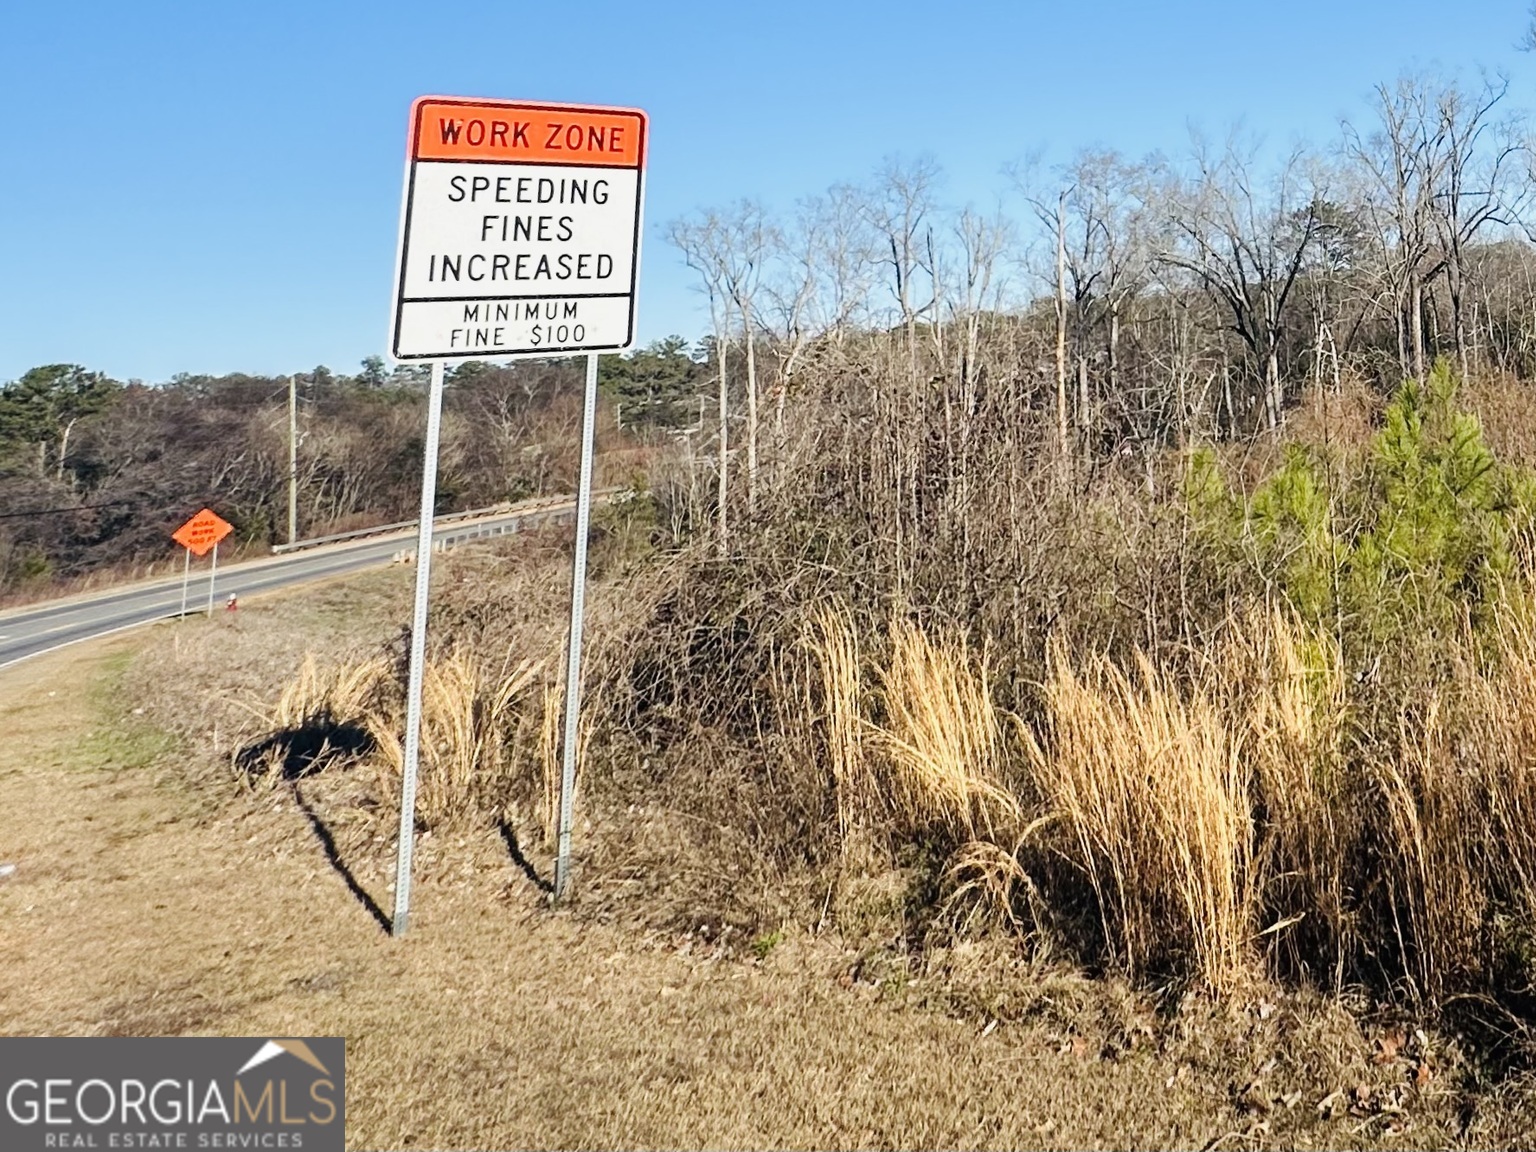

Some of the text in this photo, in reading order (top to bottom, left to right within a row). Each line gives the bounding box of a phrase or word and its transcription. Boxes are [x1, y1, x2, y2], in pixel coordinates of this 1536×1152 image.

[439, 118, 625, 153] WORK ZONE
[448, 176, 610, 205] SPEEDING
[481, 215, 574, 242] FINES
[429, 254, 613, 282] INCREASED
[463, 302, 578, 323] MINIMUM
[450, 324, 585, 348] FINE $100
